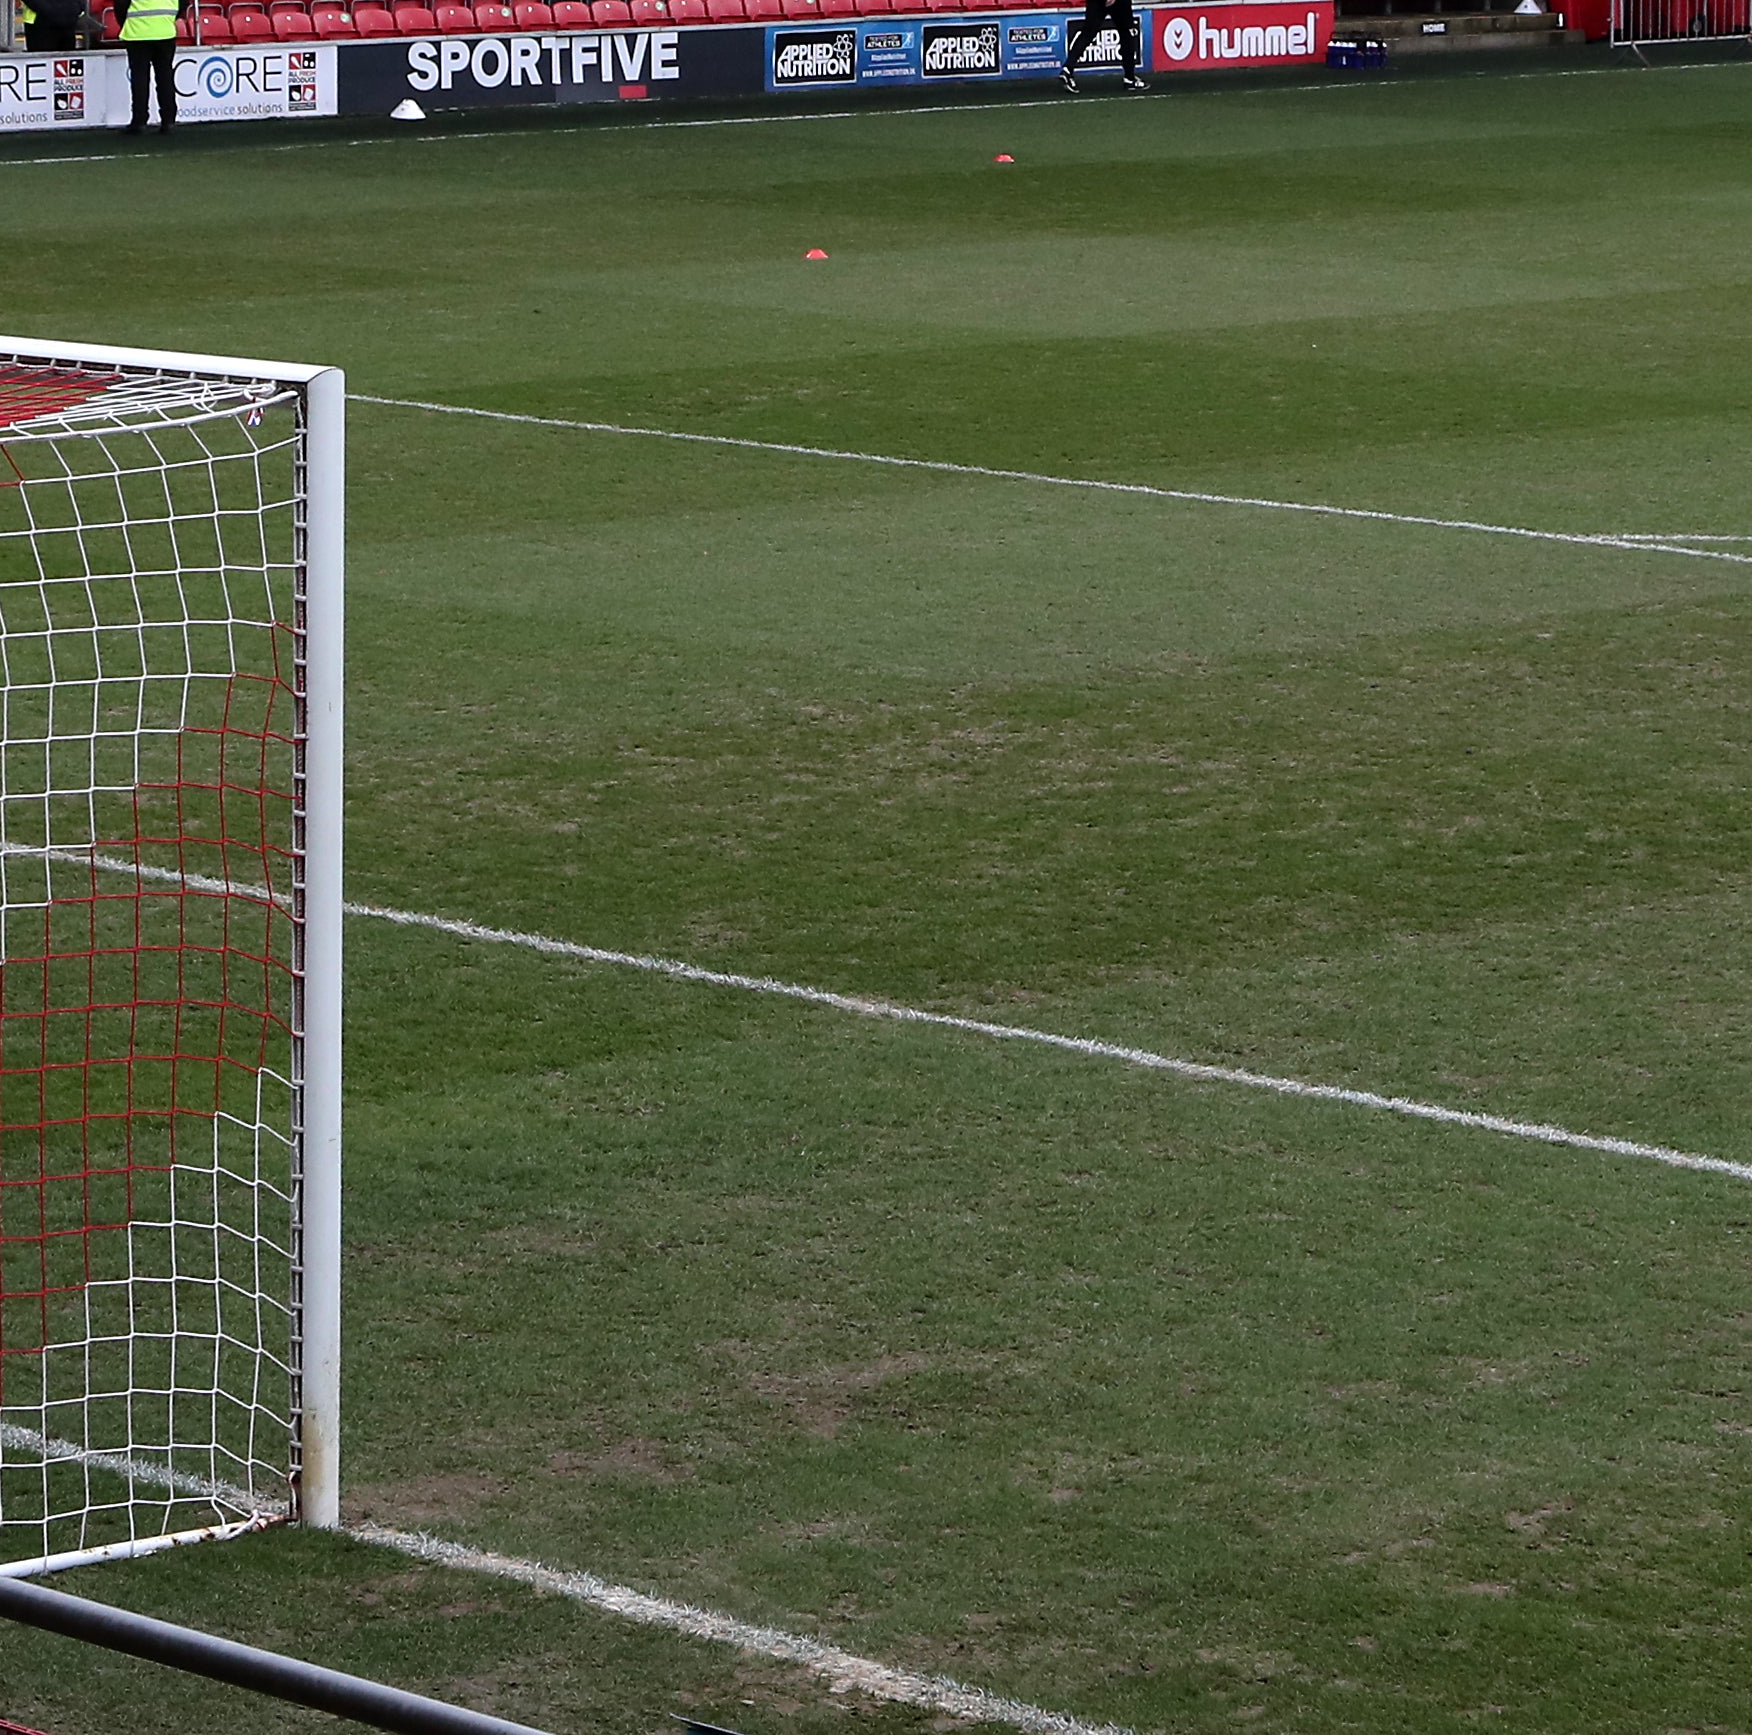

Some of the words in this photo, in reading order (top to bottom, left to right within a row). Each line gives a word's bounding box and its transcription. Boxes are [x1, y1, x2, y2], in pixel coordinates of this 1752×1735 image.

[924, 35, 979, 56] APPLIED
[1199, 16, 1316, 59] hummel
[406, 31, 681, 92] SPORTFIVE
[778, 43, 834, 63] APPLIED
[925, 50, 996, 71] NUTRITION
[778, 57, 851, 79] NUTRITION
